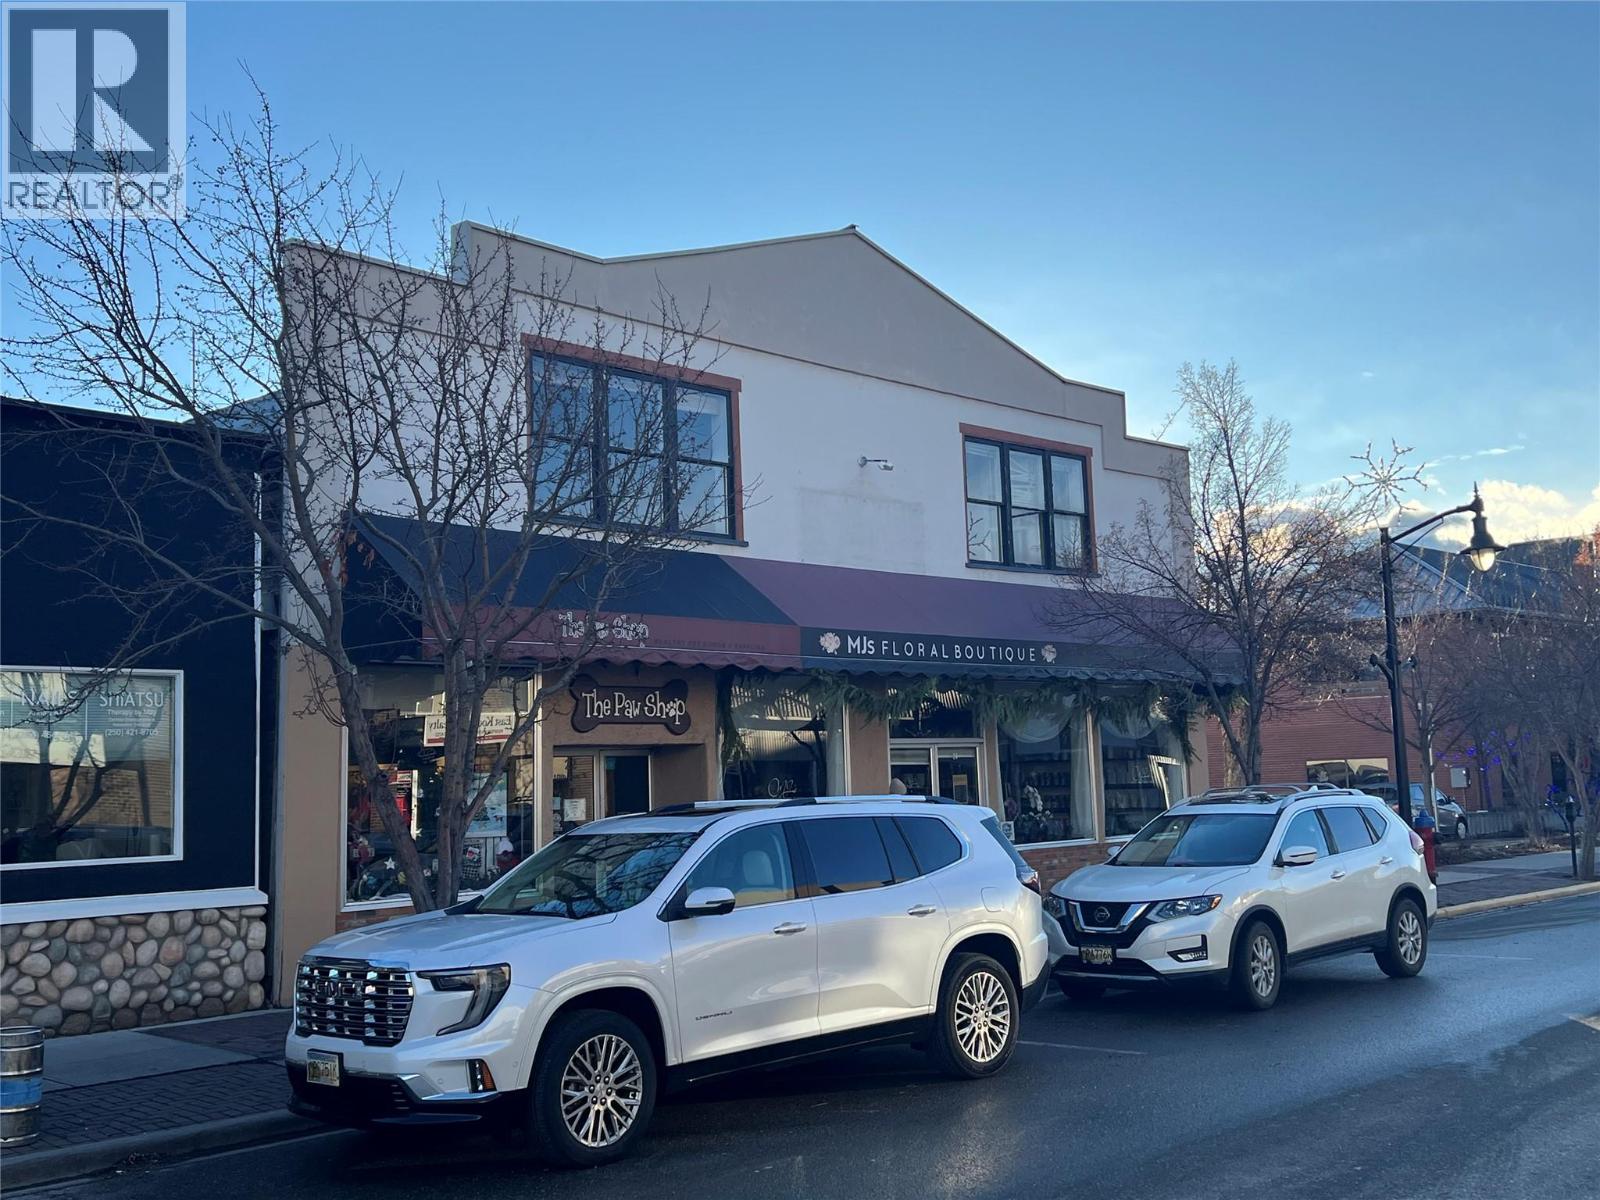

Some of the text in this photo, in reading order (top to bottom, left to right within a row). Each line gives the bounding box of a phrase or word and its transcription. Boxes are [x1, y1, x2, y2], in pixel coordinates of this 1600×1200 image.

[847, 634, 1036, 663] MJs FLORAL BOUTIQUE
[581, 688, 611, 719] The
[613, 691, 641, 719] Paw
